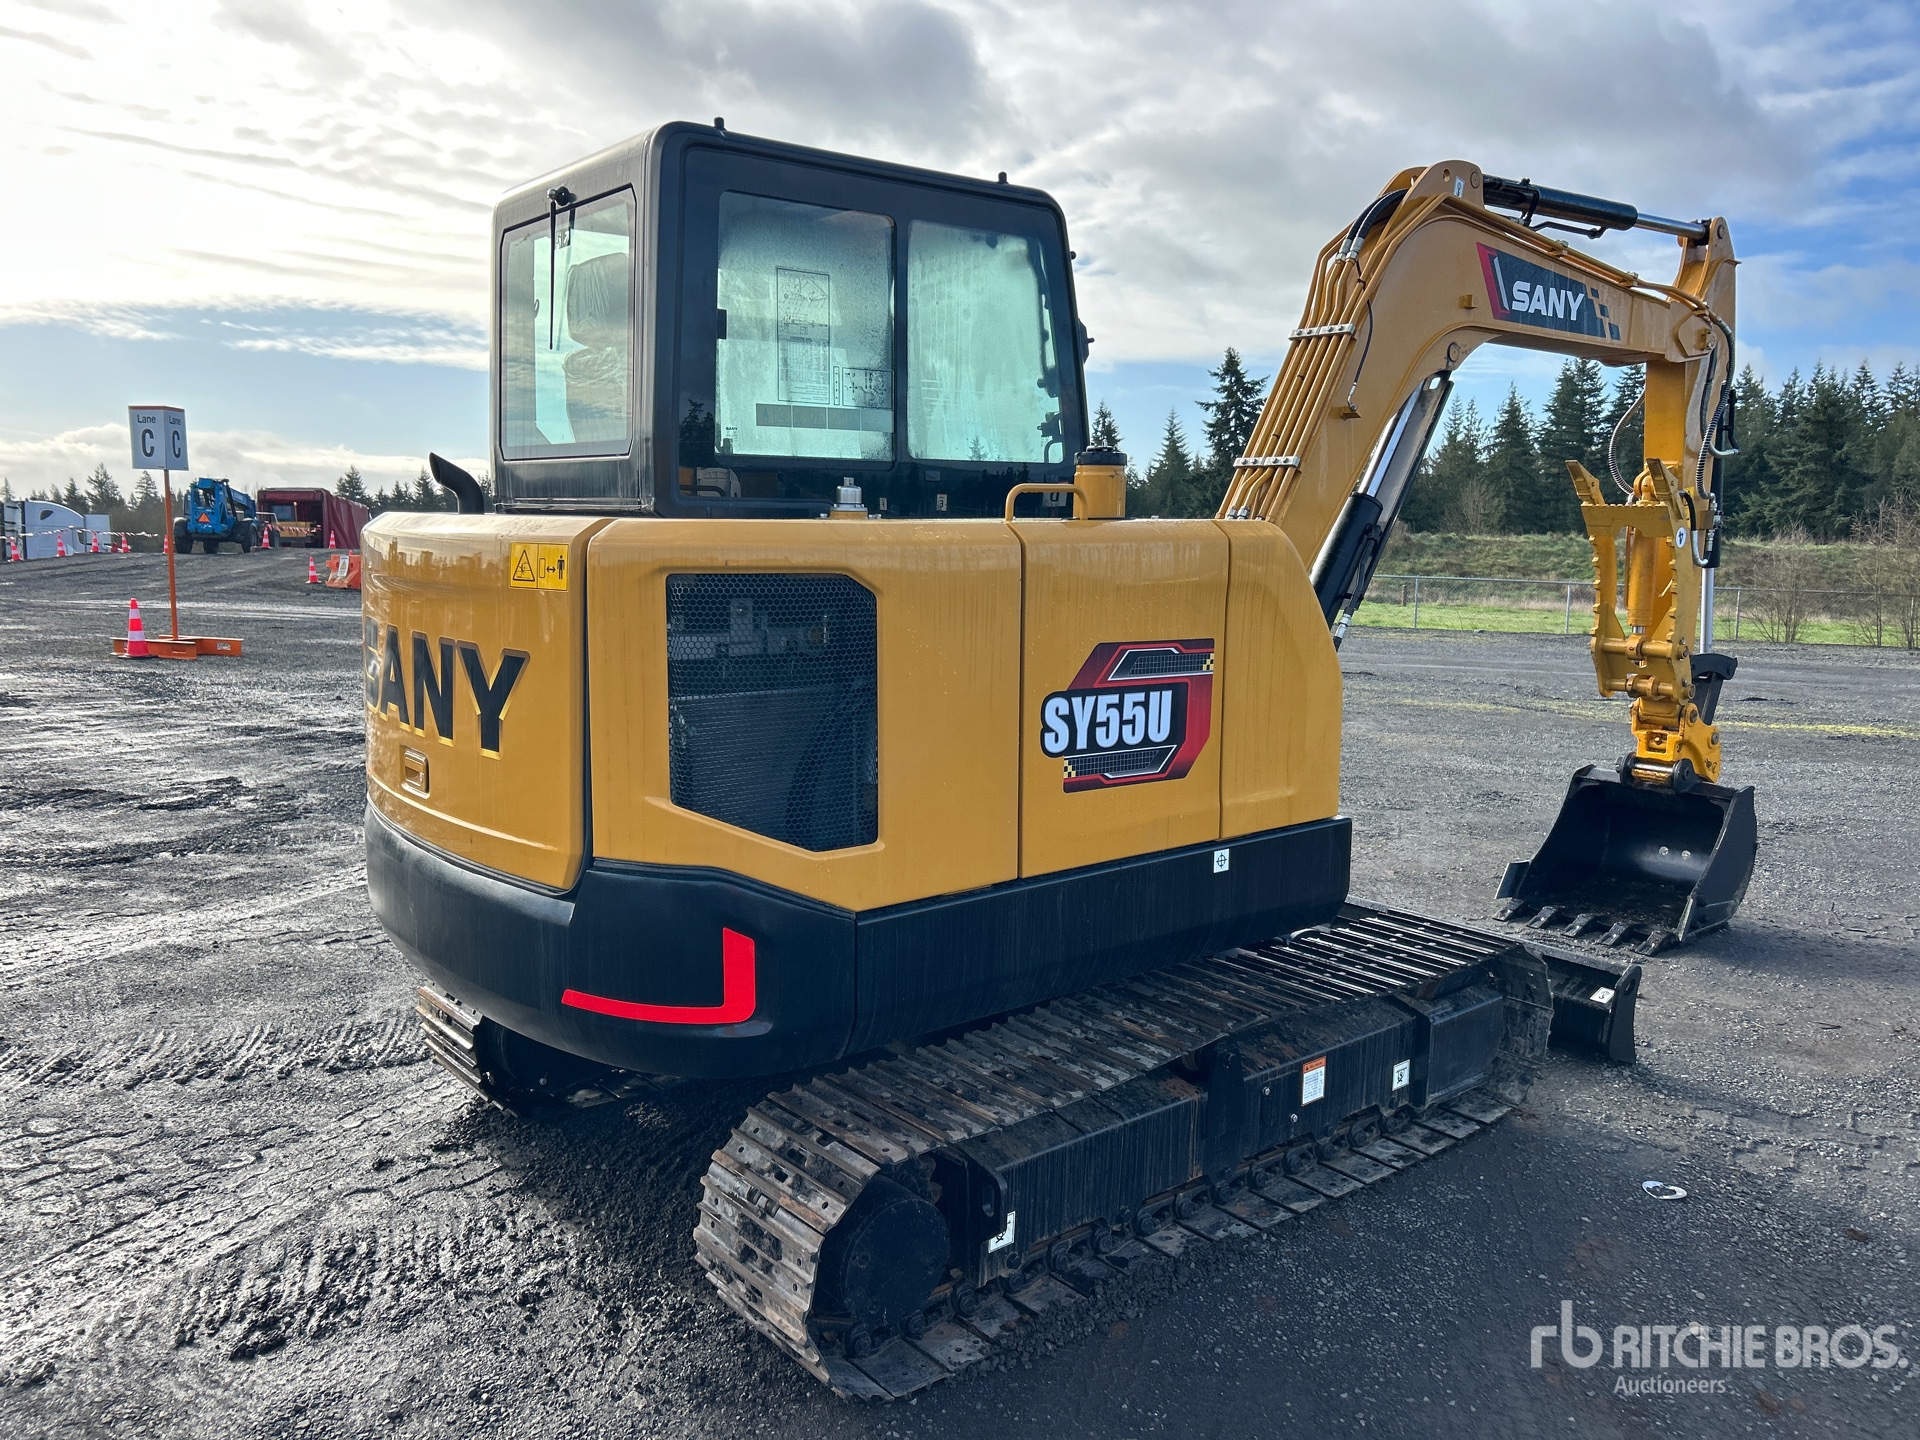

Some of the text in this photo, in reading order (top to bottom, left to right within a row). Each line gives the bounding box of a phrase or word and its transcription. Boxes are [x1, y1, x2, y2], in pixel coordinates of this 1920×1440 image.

[1512, 281, 1584, 321] SANY
[137, 414, 156, 424] Lane
[142, 429, 155, 457] C
[172, 430, 181, 458] C
[1044, 690, 1173, 754] SY55U
